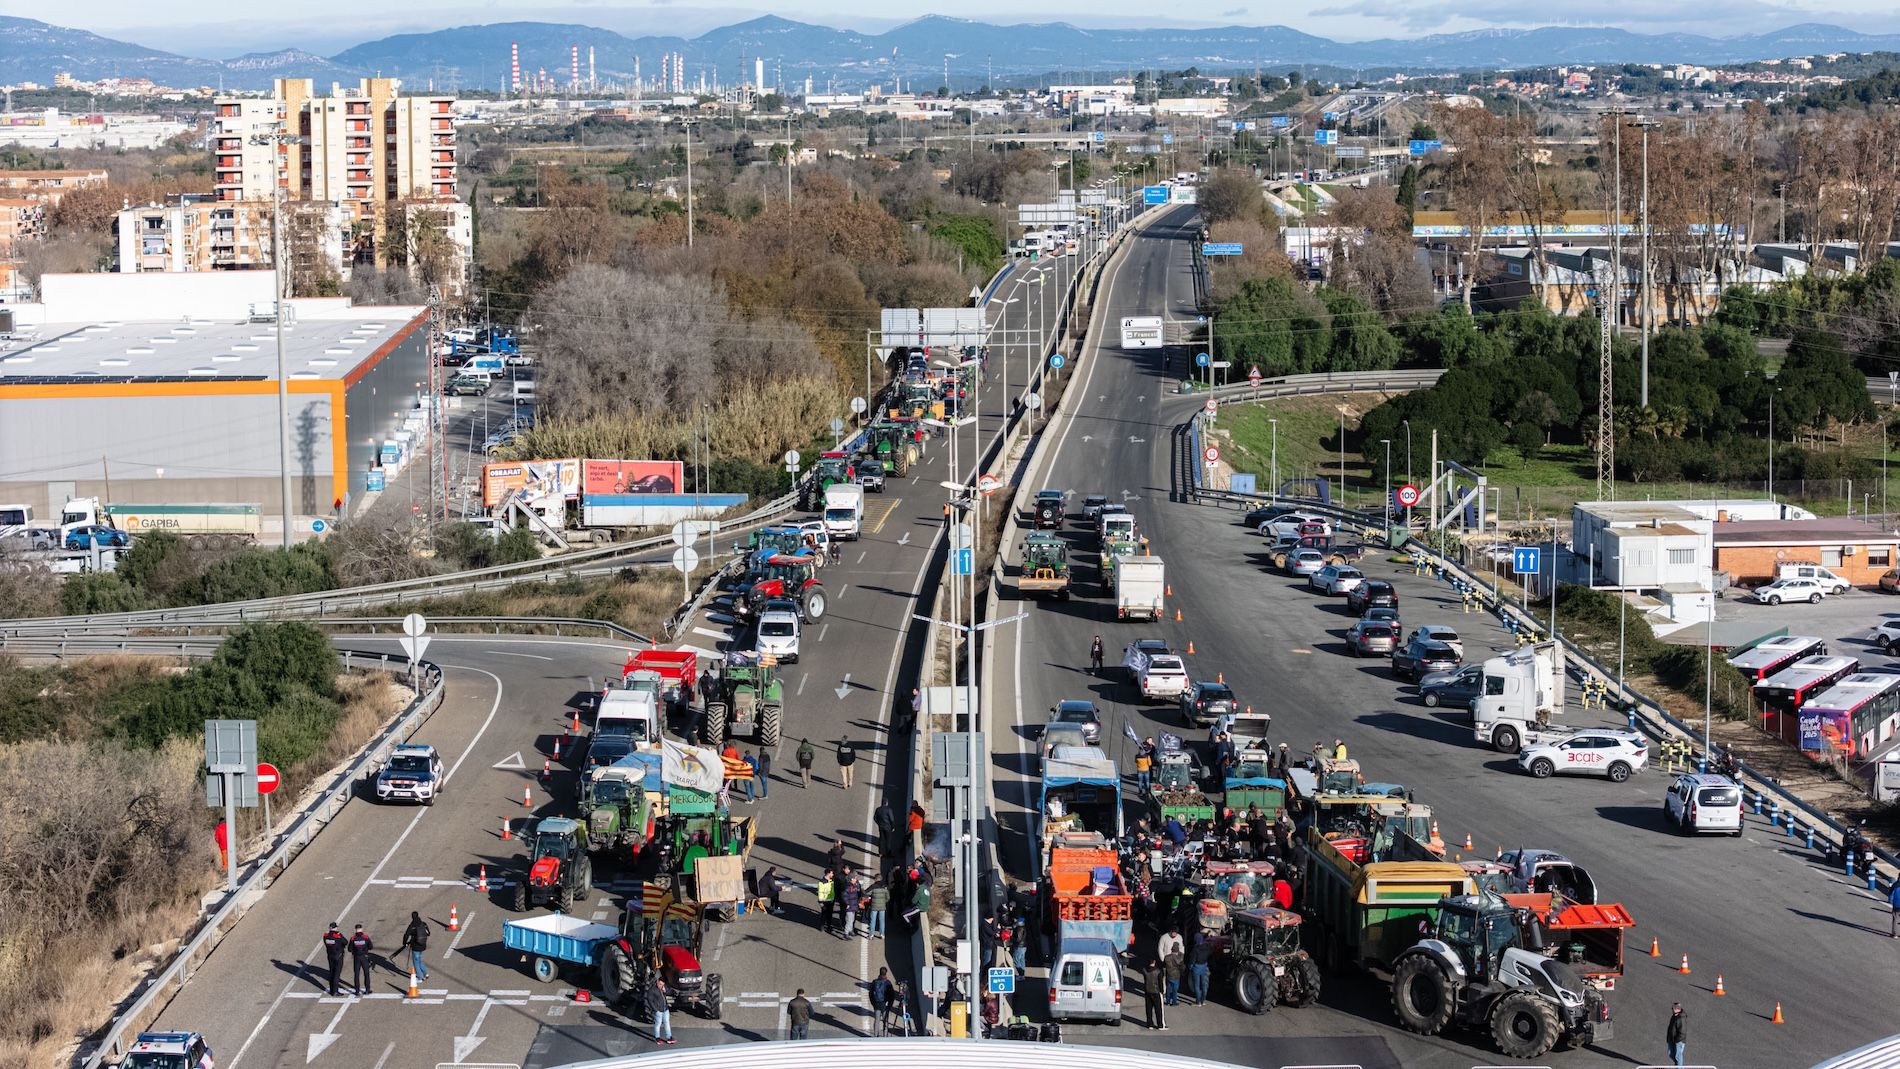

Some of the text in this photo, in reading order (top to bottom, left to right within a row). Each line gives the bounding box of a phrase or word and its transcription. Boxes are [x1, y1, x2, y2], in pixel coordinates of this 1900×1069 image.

[490, 468, 521, 477] OBRAMAT
[1402, 491, 1415, 499] 100
[141, 518, 180, 528] GAPIBA
[1567, 752, 1596, 763] 3cat
[672, 794, 716, 805] MERCOSUR
[707, 860, 731, 875] NO
